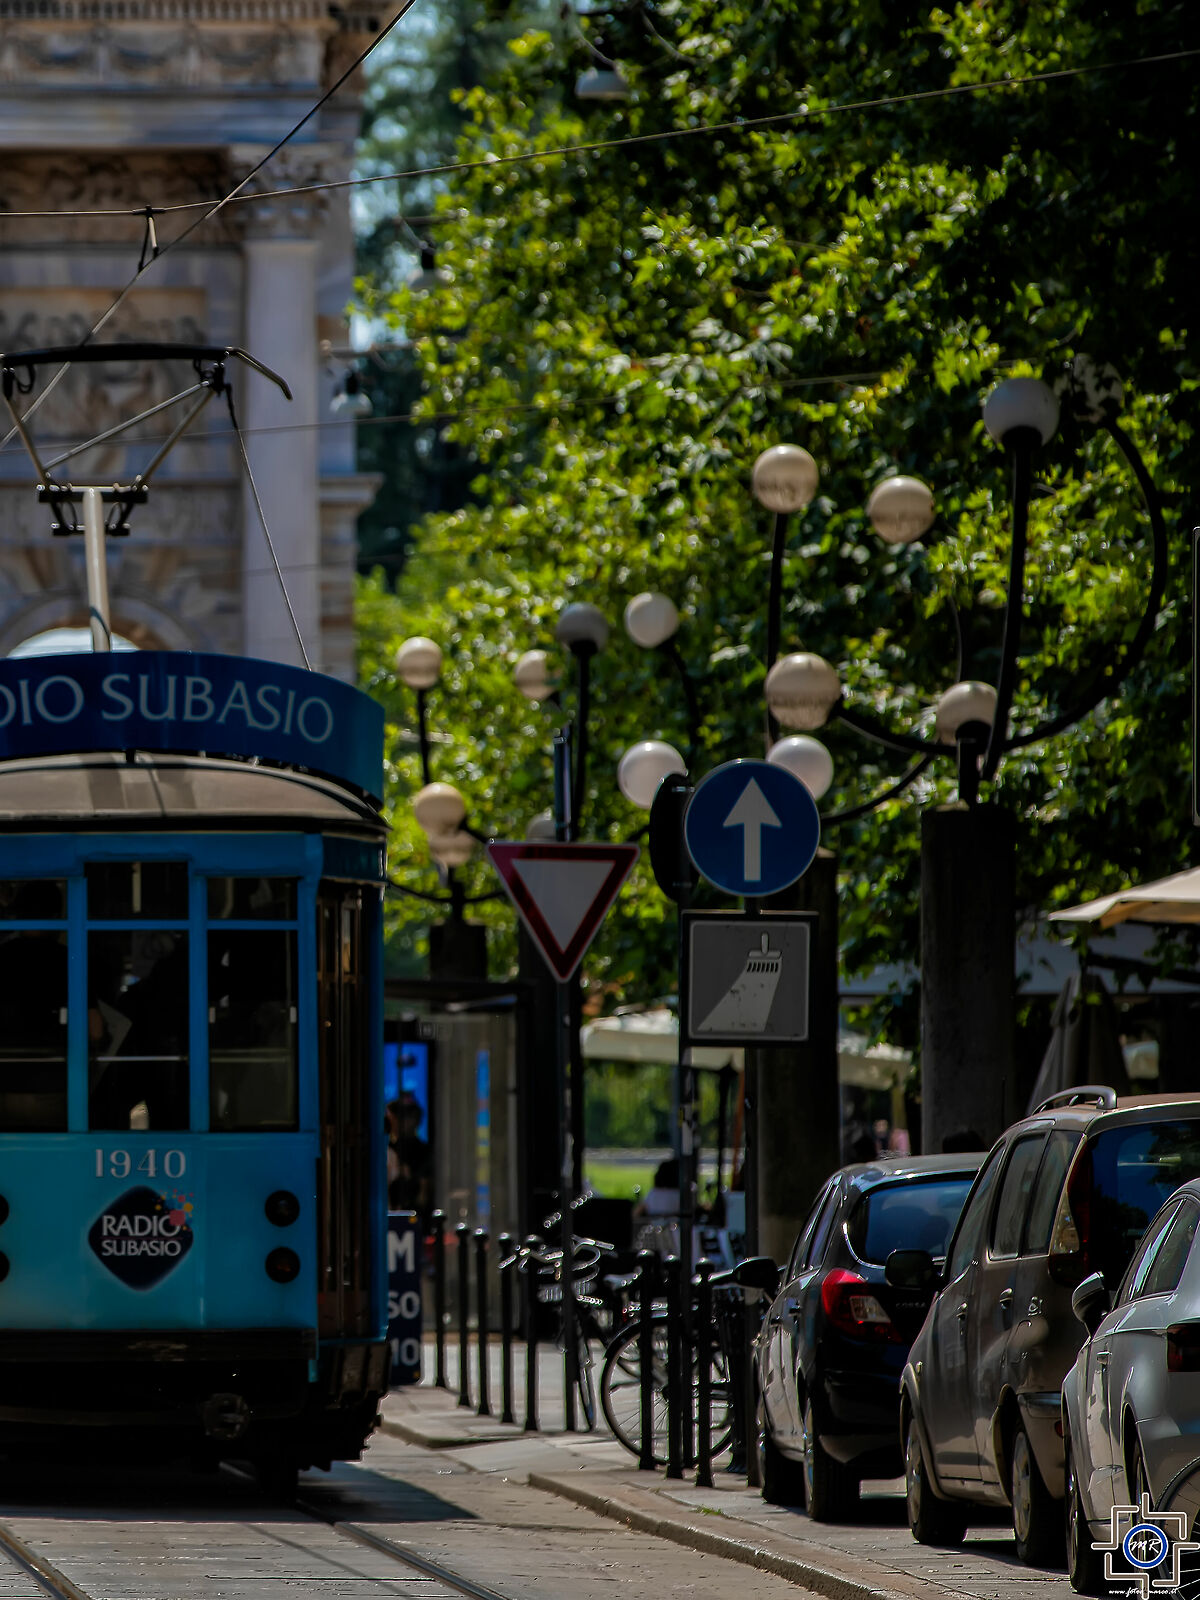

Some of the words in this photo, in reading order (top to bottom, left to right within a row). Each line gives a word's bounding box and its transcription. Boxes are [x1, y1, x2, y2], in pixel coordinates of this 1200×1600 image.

[101, 673, 334, 743] SUBASIO
[95, 1149, 187, 1178] 1940
[101, 1214, 182, 1237] RADIO
[101, 1239, 182, 1257] SUBASIO
